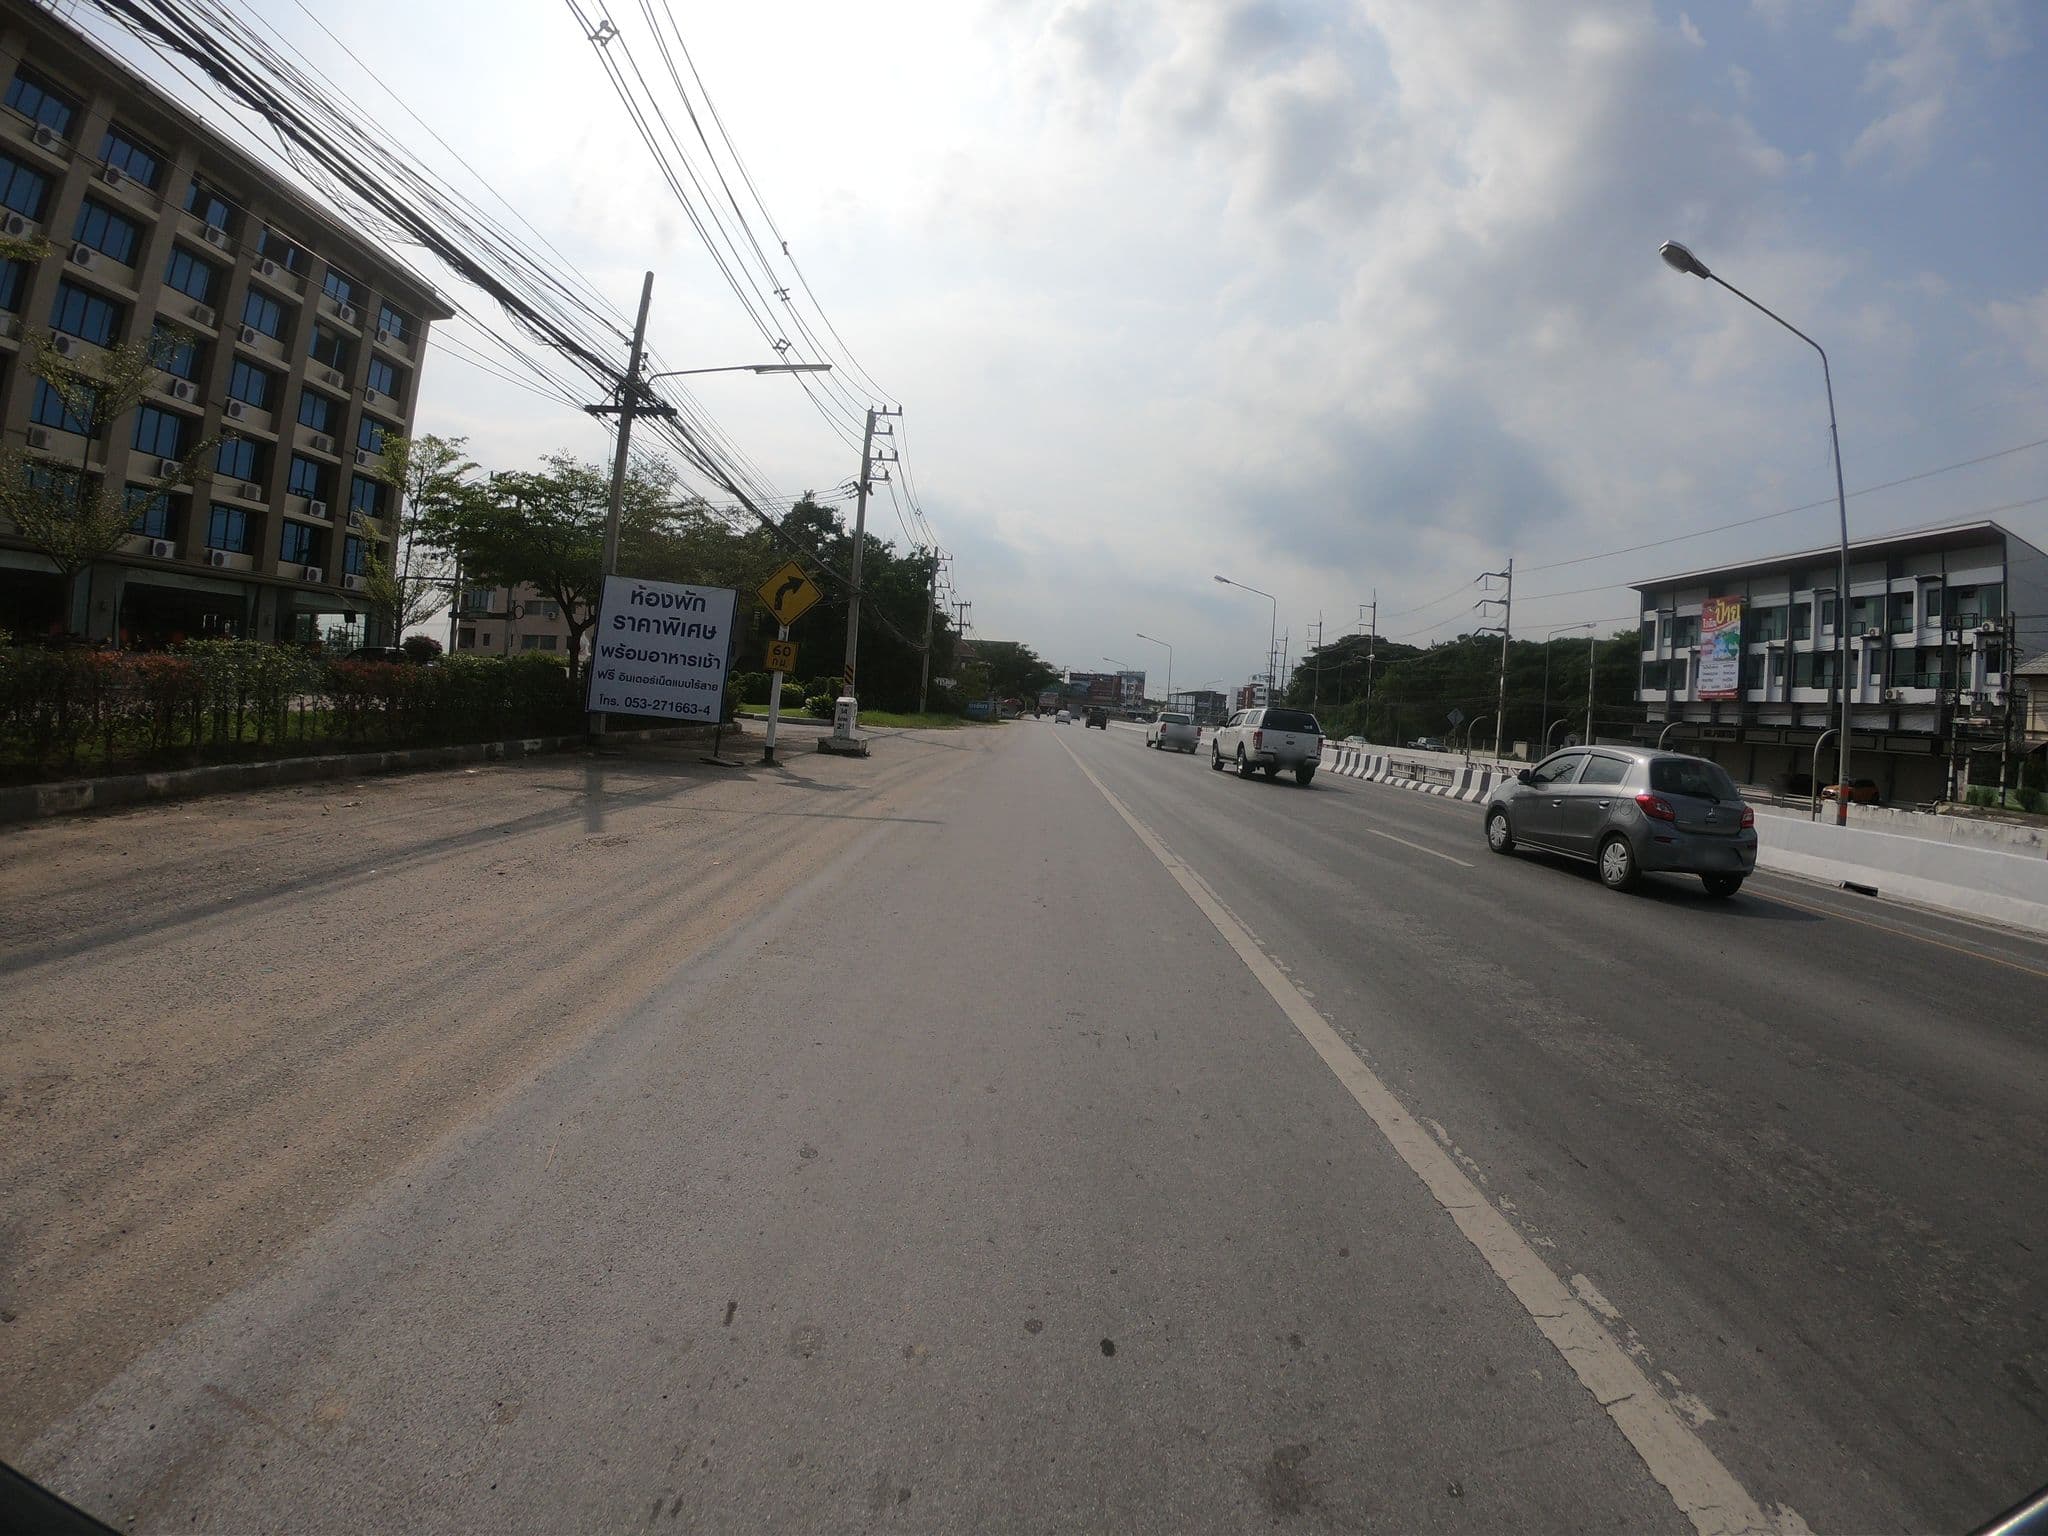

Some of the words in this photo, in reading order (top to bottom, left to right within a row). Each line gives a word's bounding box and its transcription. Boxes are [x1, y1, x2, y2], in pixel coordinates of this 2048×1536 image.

[630, 585, 706, 613] ห้องพัก
[613, 615, 717, 640] ราคาพิเศษ
[600, 643, 720, 669] พร้อมอาหารเช้า
[773, 645, 791, 657] 60
[597, 668, 616, 681] ฟรี
[600, 693, 620, 707] โทร.
[624, 696, 711, 716] 053-271663-4
